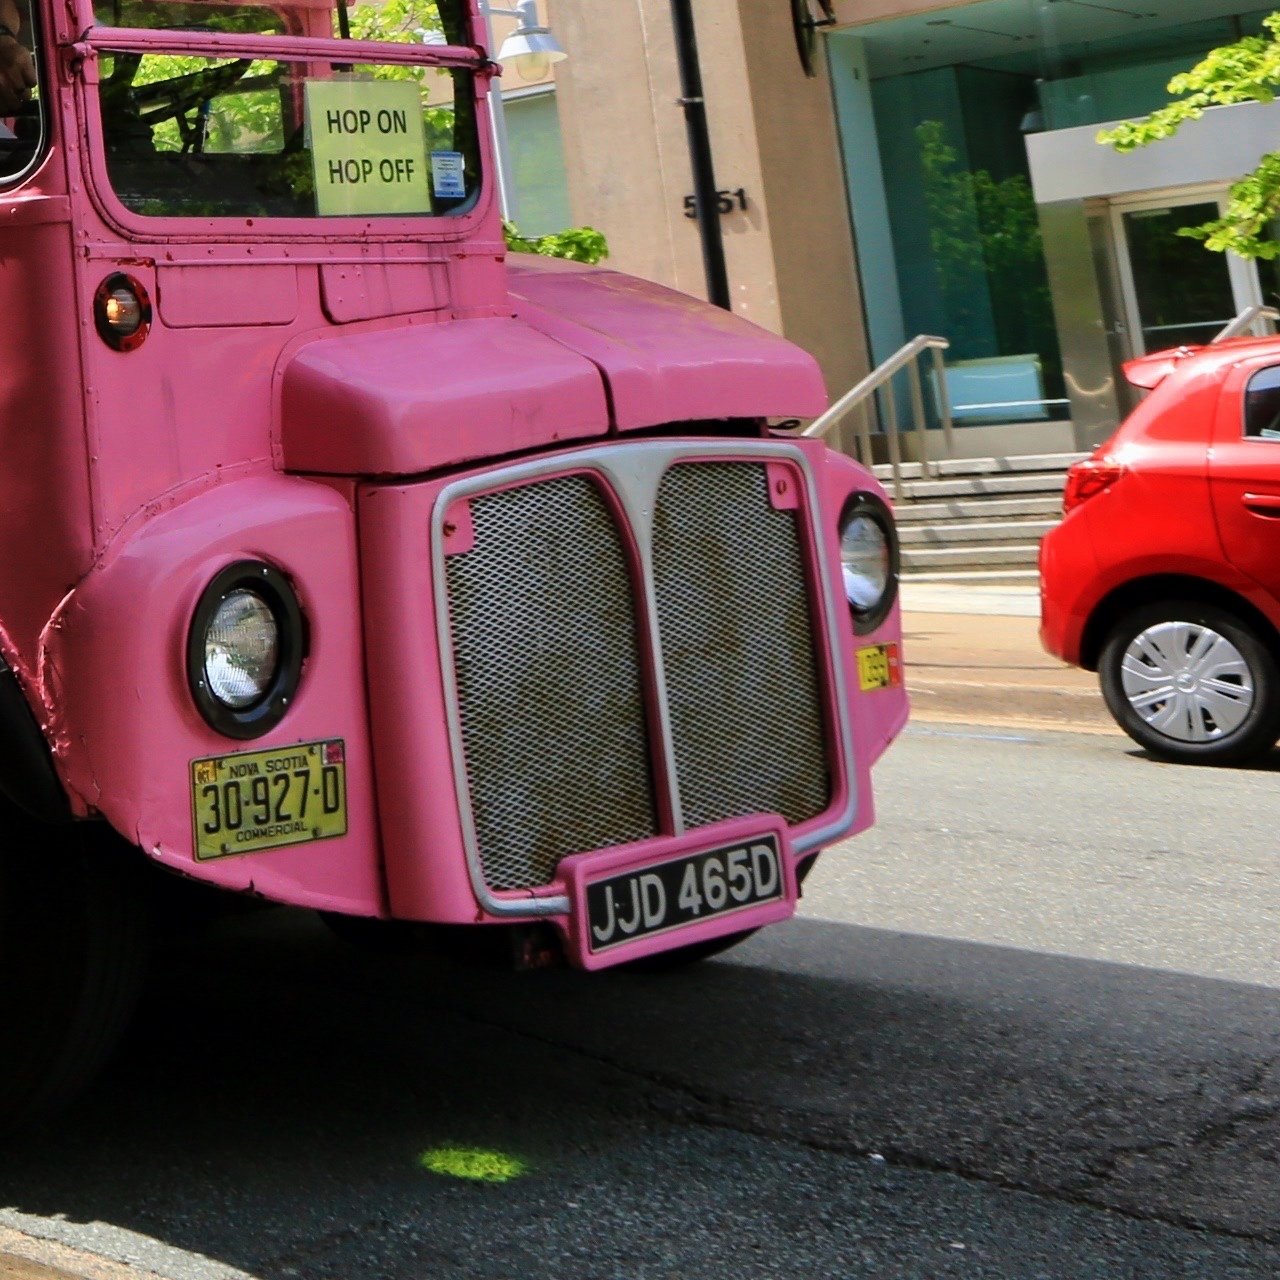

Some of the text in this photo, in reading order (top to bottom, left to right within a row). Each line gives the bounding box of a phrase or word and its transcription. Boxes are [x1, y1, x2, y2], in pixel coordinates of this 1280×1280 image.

[326, 109, 407, 134] HOP ON
[328, 158, 373, 184] HOP
[379, 158, 414, 183] OFF
[682, 187, 747, 219] 551
[229, 755, 309, 779] NOVA SCOTIA
[236, 821, 309, 843] COMMERCIAL
[592, 844, 779, 942] JJD 465D
